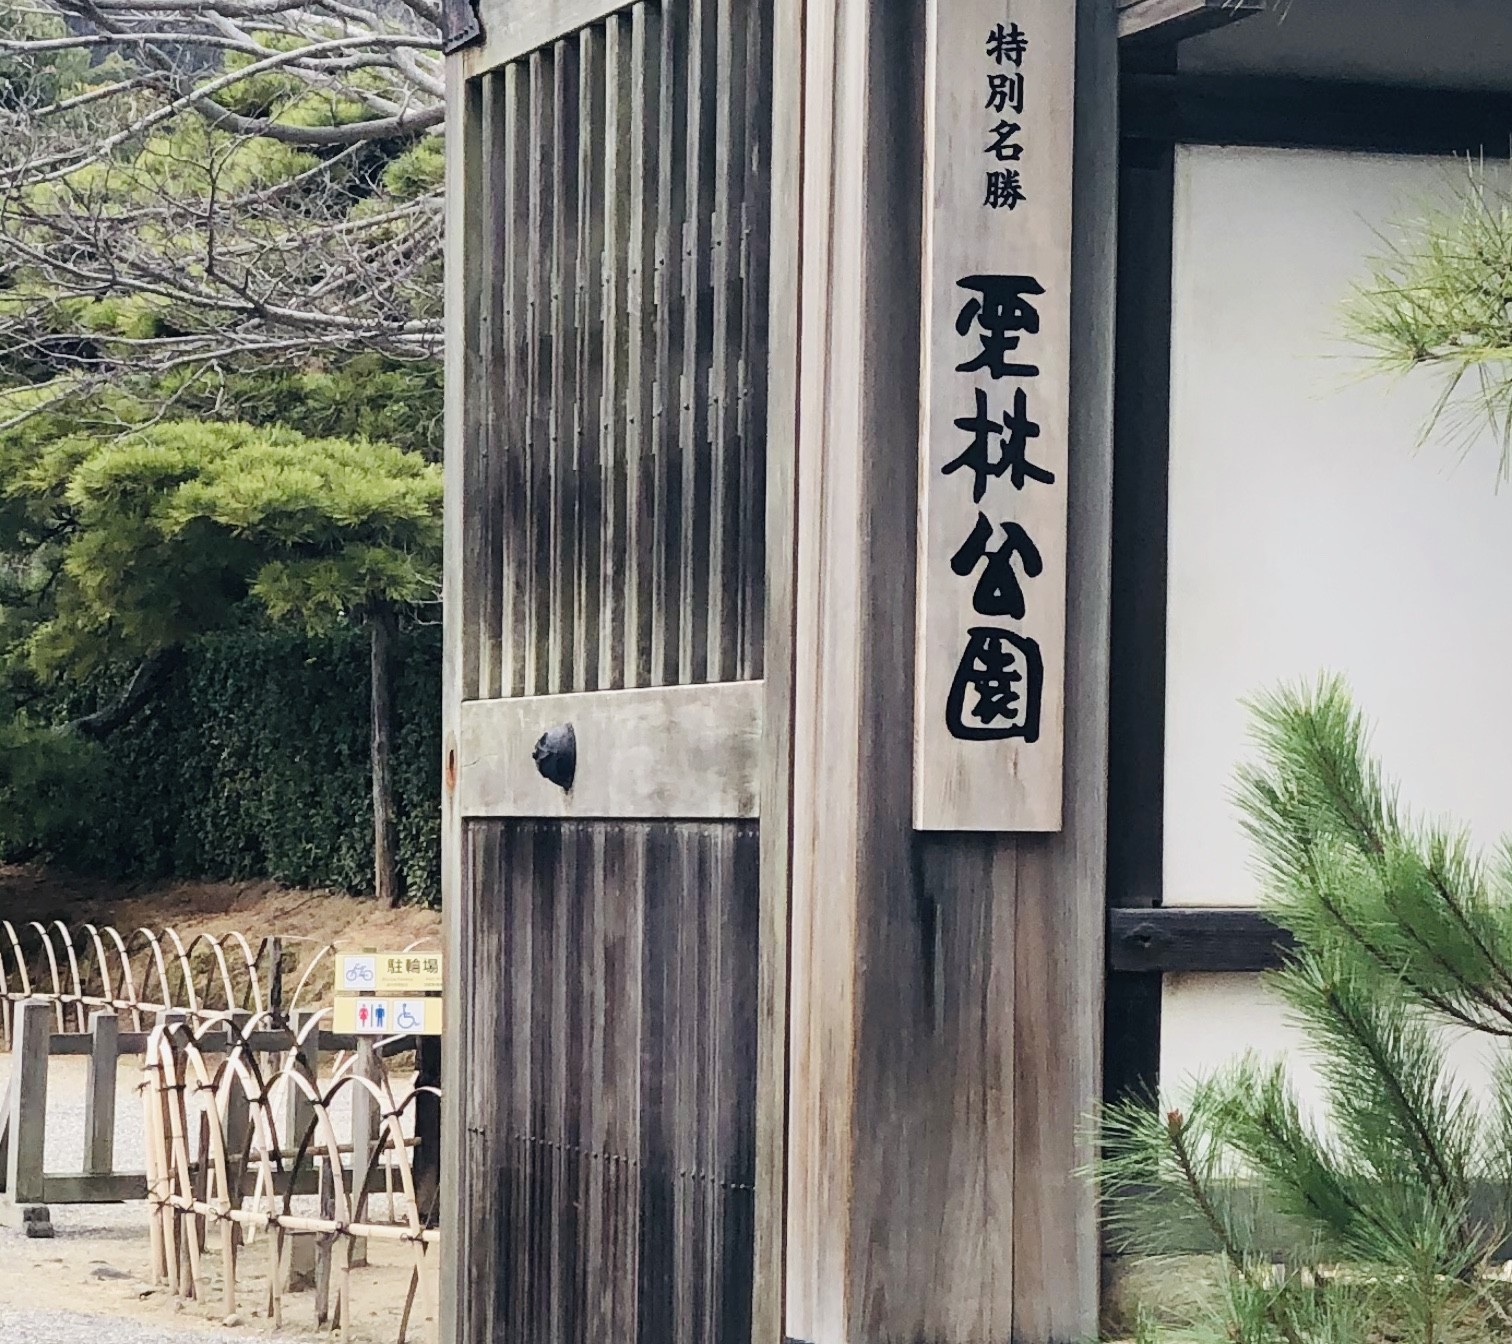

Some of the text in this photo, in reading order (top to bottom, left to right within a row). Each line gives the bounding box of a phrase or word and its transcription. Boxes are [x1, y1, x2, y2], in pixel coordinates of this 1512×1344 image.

[983, 21, 1029, 211] 特別名勝
[941, 274, 1056, 744] 栗林公園
[387, 958, 439, 974] 駐輪場
